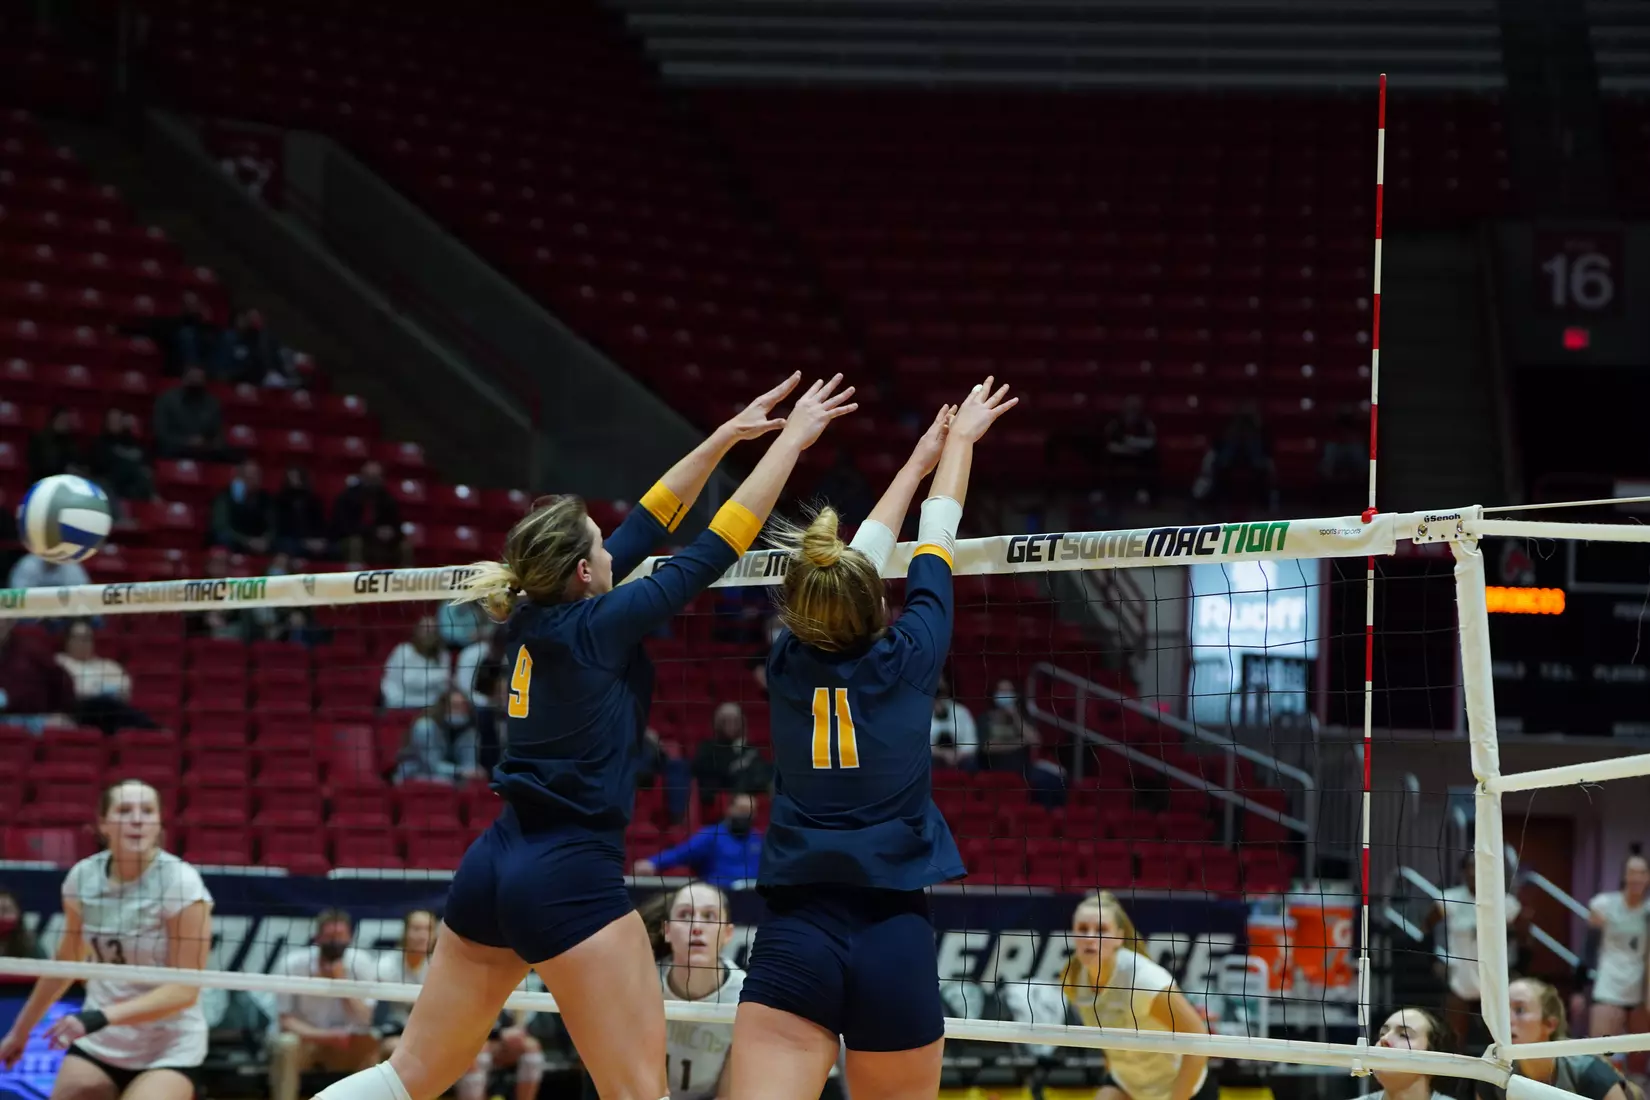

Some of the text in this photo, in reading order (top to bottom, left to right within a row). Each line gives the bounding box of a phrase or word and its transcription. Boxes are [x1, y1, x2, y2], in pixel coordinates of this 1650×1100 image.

[1542, 253, 1614, 311] 16
[1319, 528, 1337, 536] sports
[1430, 513, 1461, 522] Senoh
[508, 644, 533, 718] 9
[812, 687, 860, 769] 11
